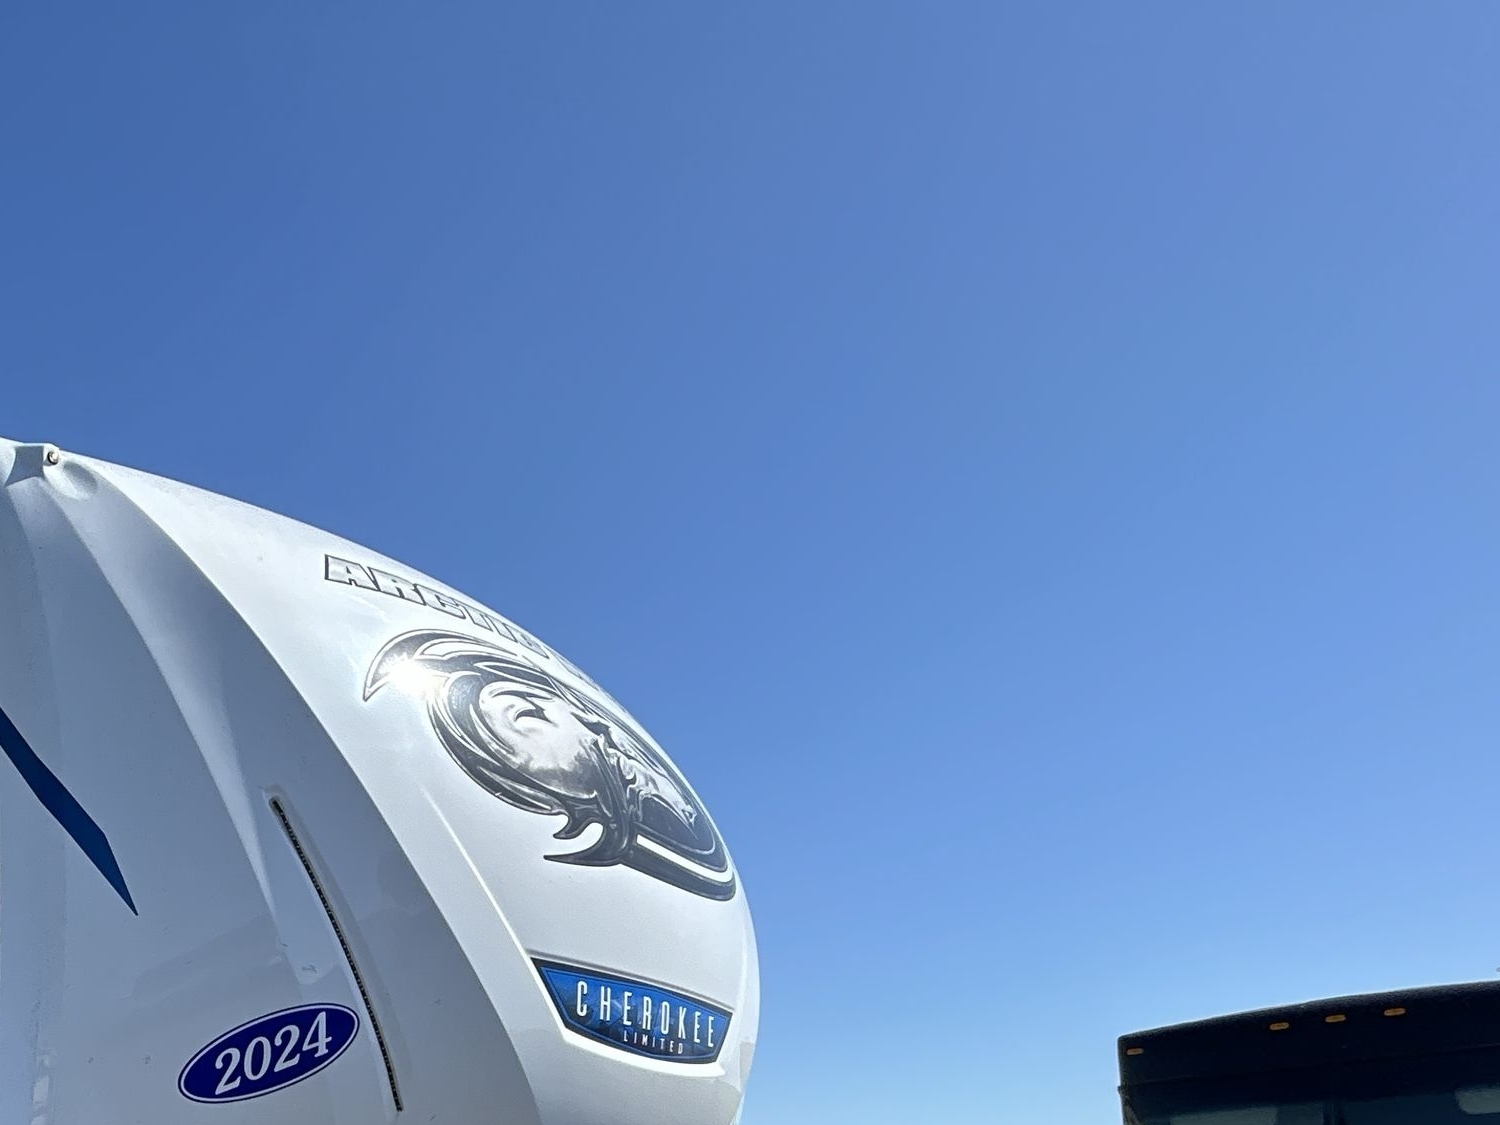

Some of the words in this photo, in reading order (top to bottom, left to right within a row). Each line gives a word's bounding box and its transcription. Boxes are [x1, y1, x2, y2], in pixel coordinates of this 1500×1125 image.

[576, 980, 716, 1048] CHEROKEE
[622, 1029, 684, 1055] LIMITED
[214, 1010, 333, 1095] 2024
